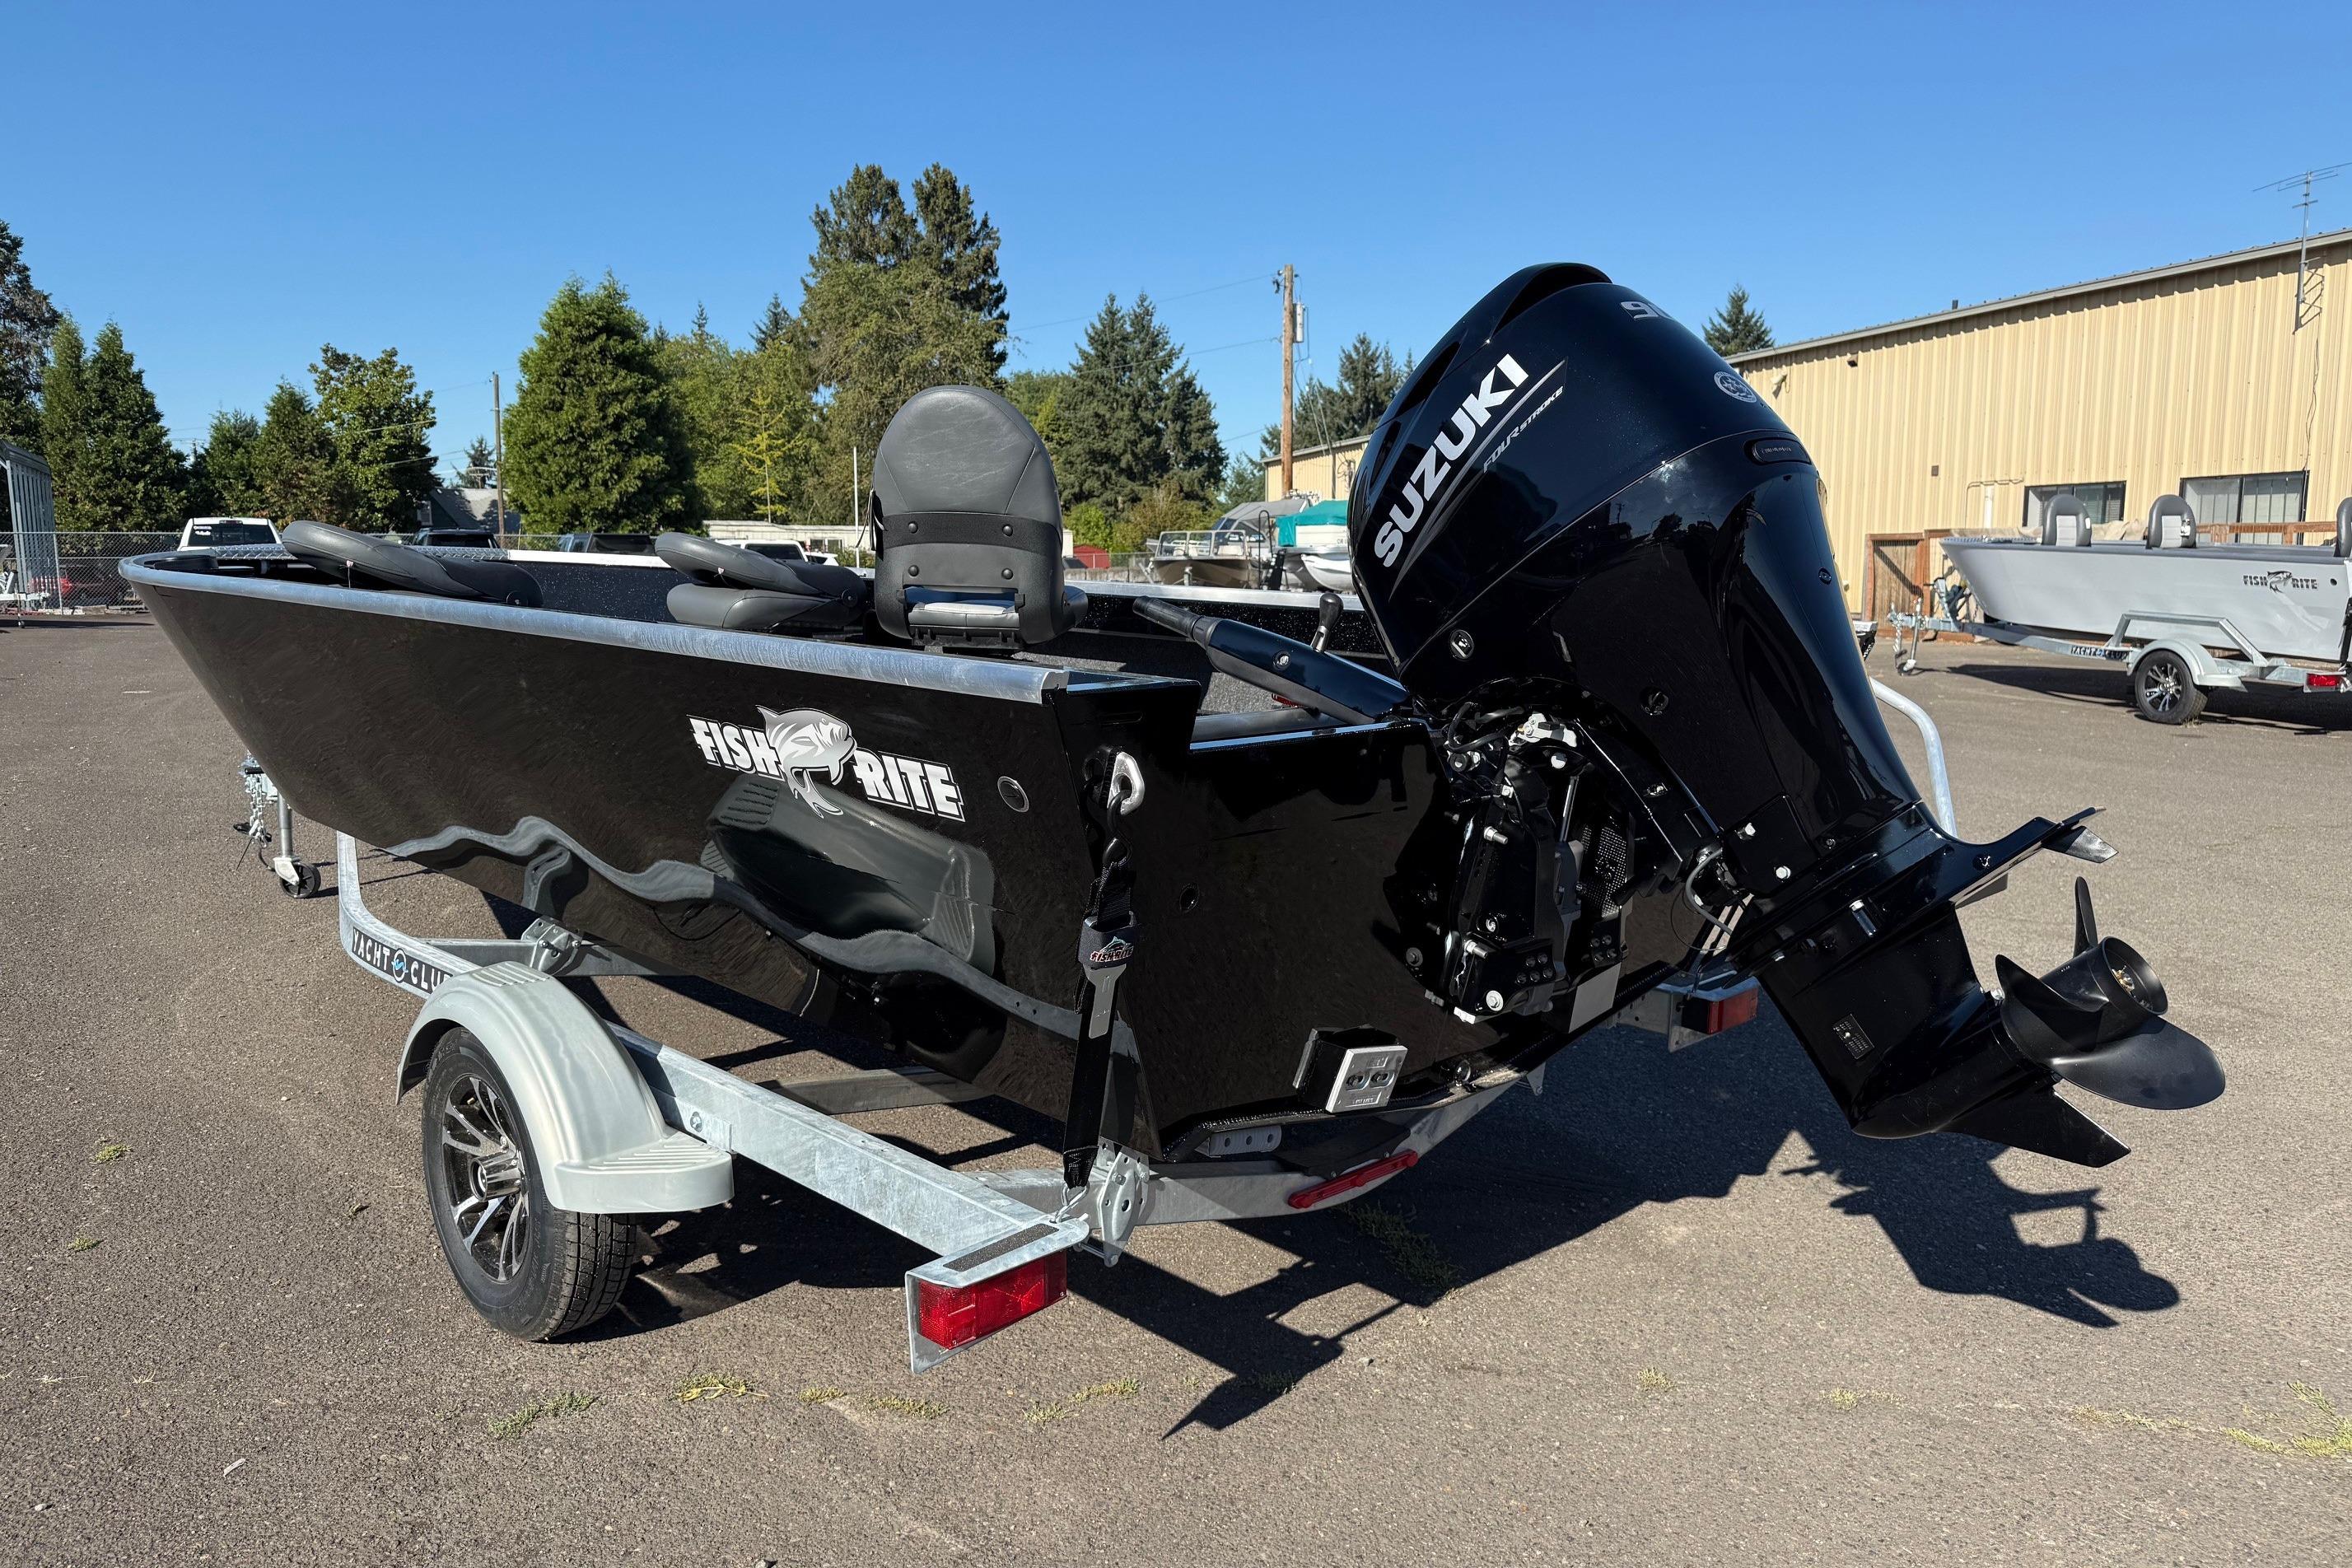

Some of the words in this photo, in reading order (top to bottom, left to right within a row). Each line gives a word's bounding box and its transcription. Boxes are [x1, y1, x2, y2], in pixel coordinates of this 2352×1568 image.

[1374, 353, 1529, 567] SUZUKI
[2242, 575, 2269, 587] FISH
[2291, 577, 2319, 590] RITE
[2071, 645, 2096, 658] YACHT
[688, 716, 785, 782] FISH
[852, 746, 965, 822] RITE
[353, 928, 390, 971] YACHT
